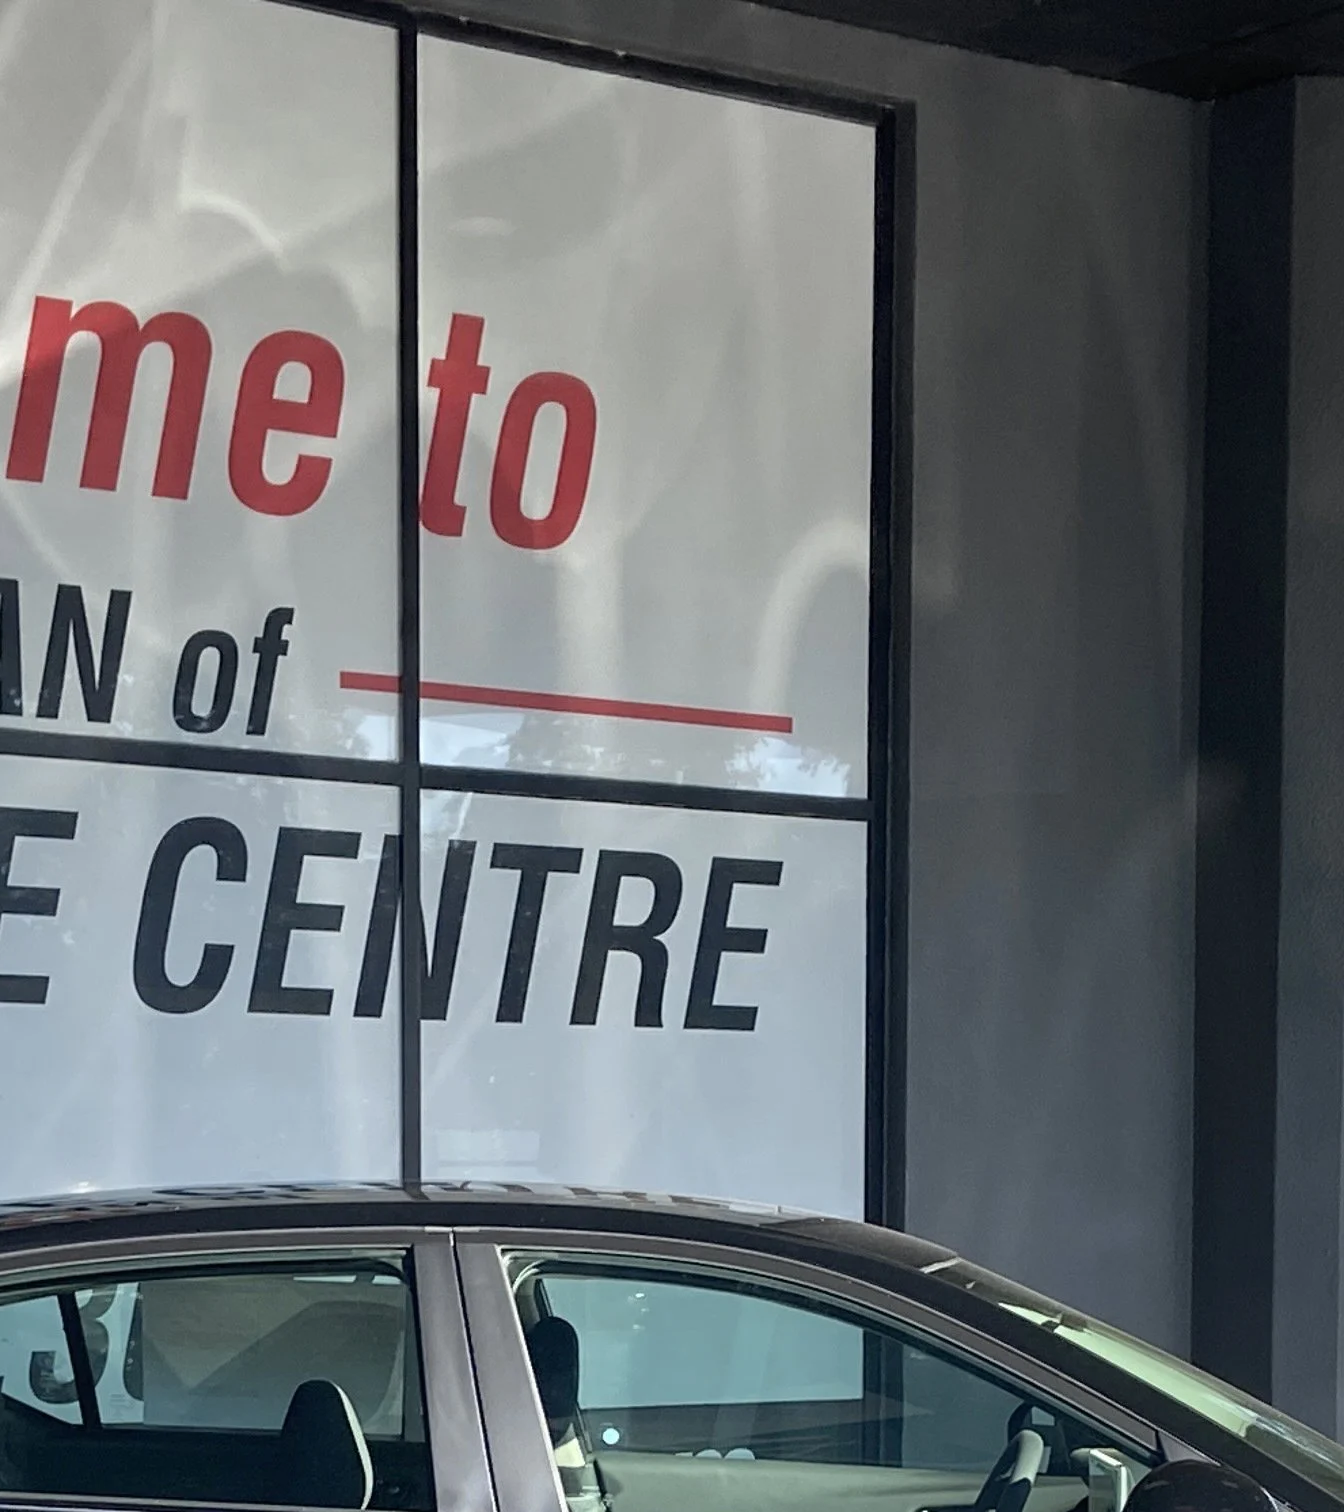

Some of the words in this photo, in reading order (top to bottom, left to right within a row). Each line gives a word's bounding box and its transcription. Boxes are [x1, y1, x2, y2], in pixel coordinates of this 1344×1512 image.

[418, 312, 598, 551] to
[171, 606, 295, 736] of
[132, 816, 784, 1032] CENTRE
